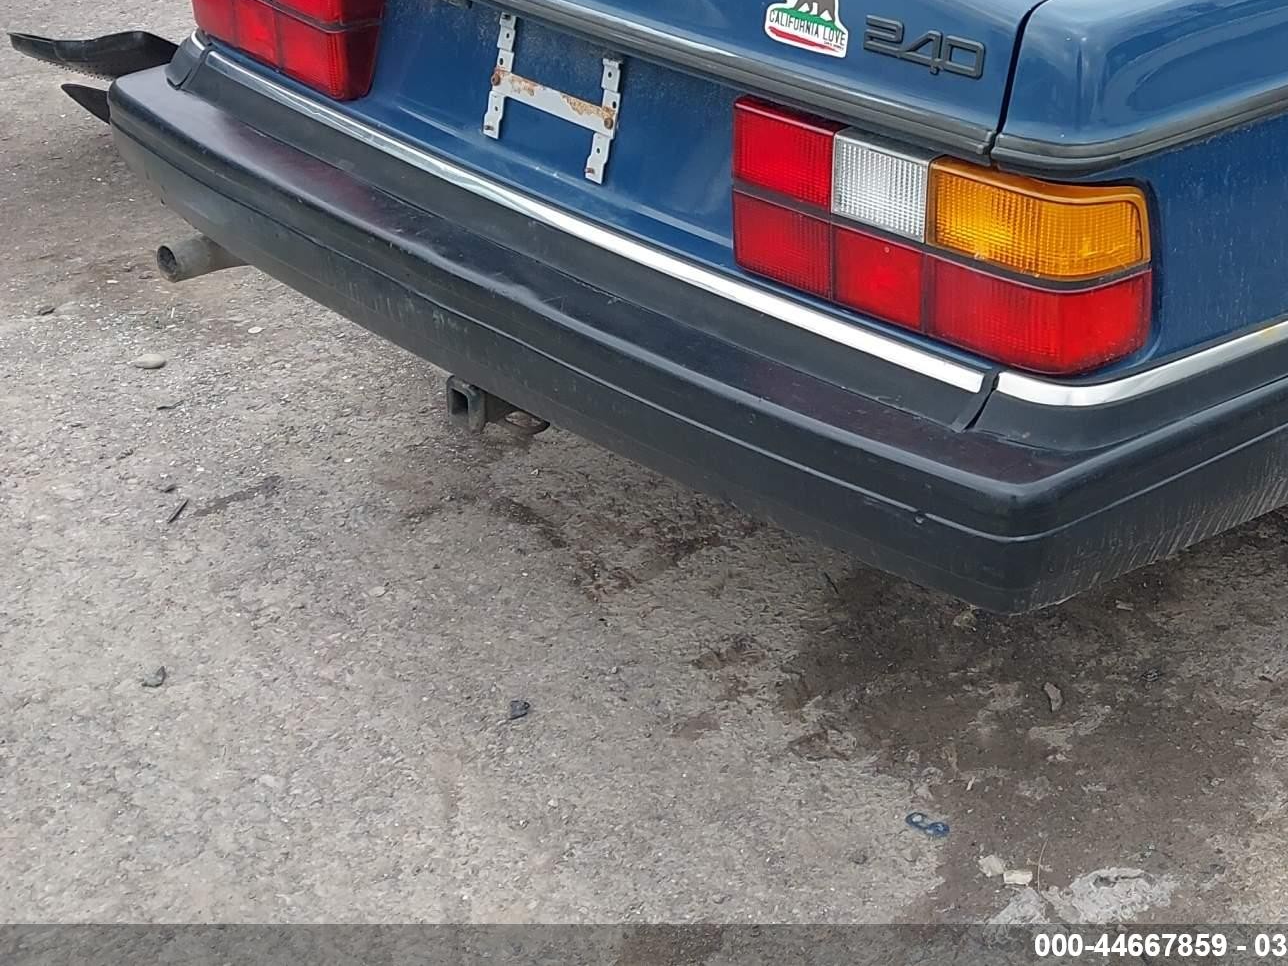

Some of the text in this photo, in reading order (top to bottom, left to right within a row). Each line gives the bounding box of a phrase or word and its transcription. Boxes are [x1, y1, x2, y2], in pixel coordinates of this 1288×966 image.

[768, 8, 821, 39] CALIFORNIA
[821, 27, 847, 47] LOVE
[863, 14, 986, 80] 240
